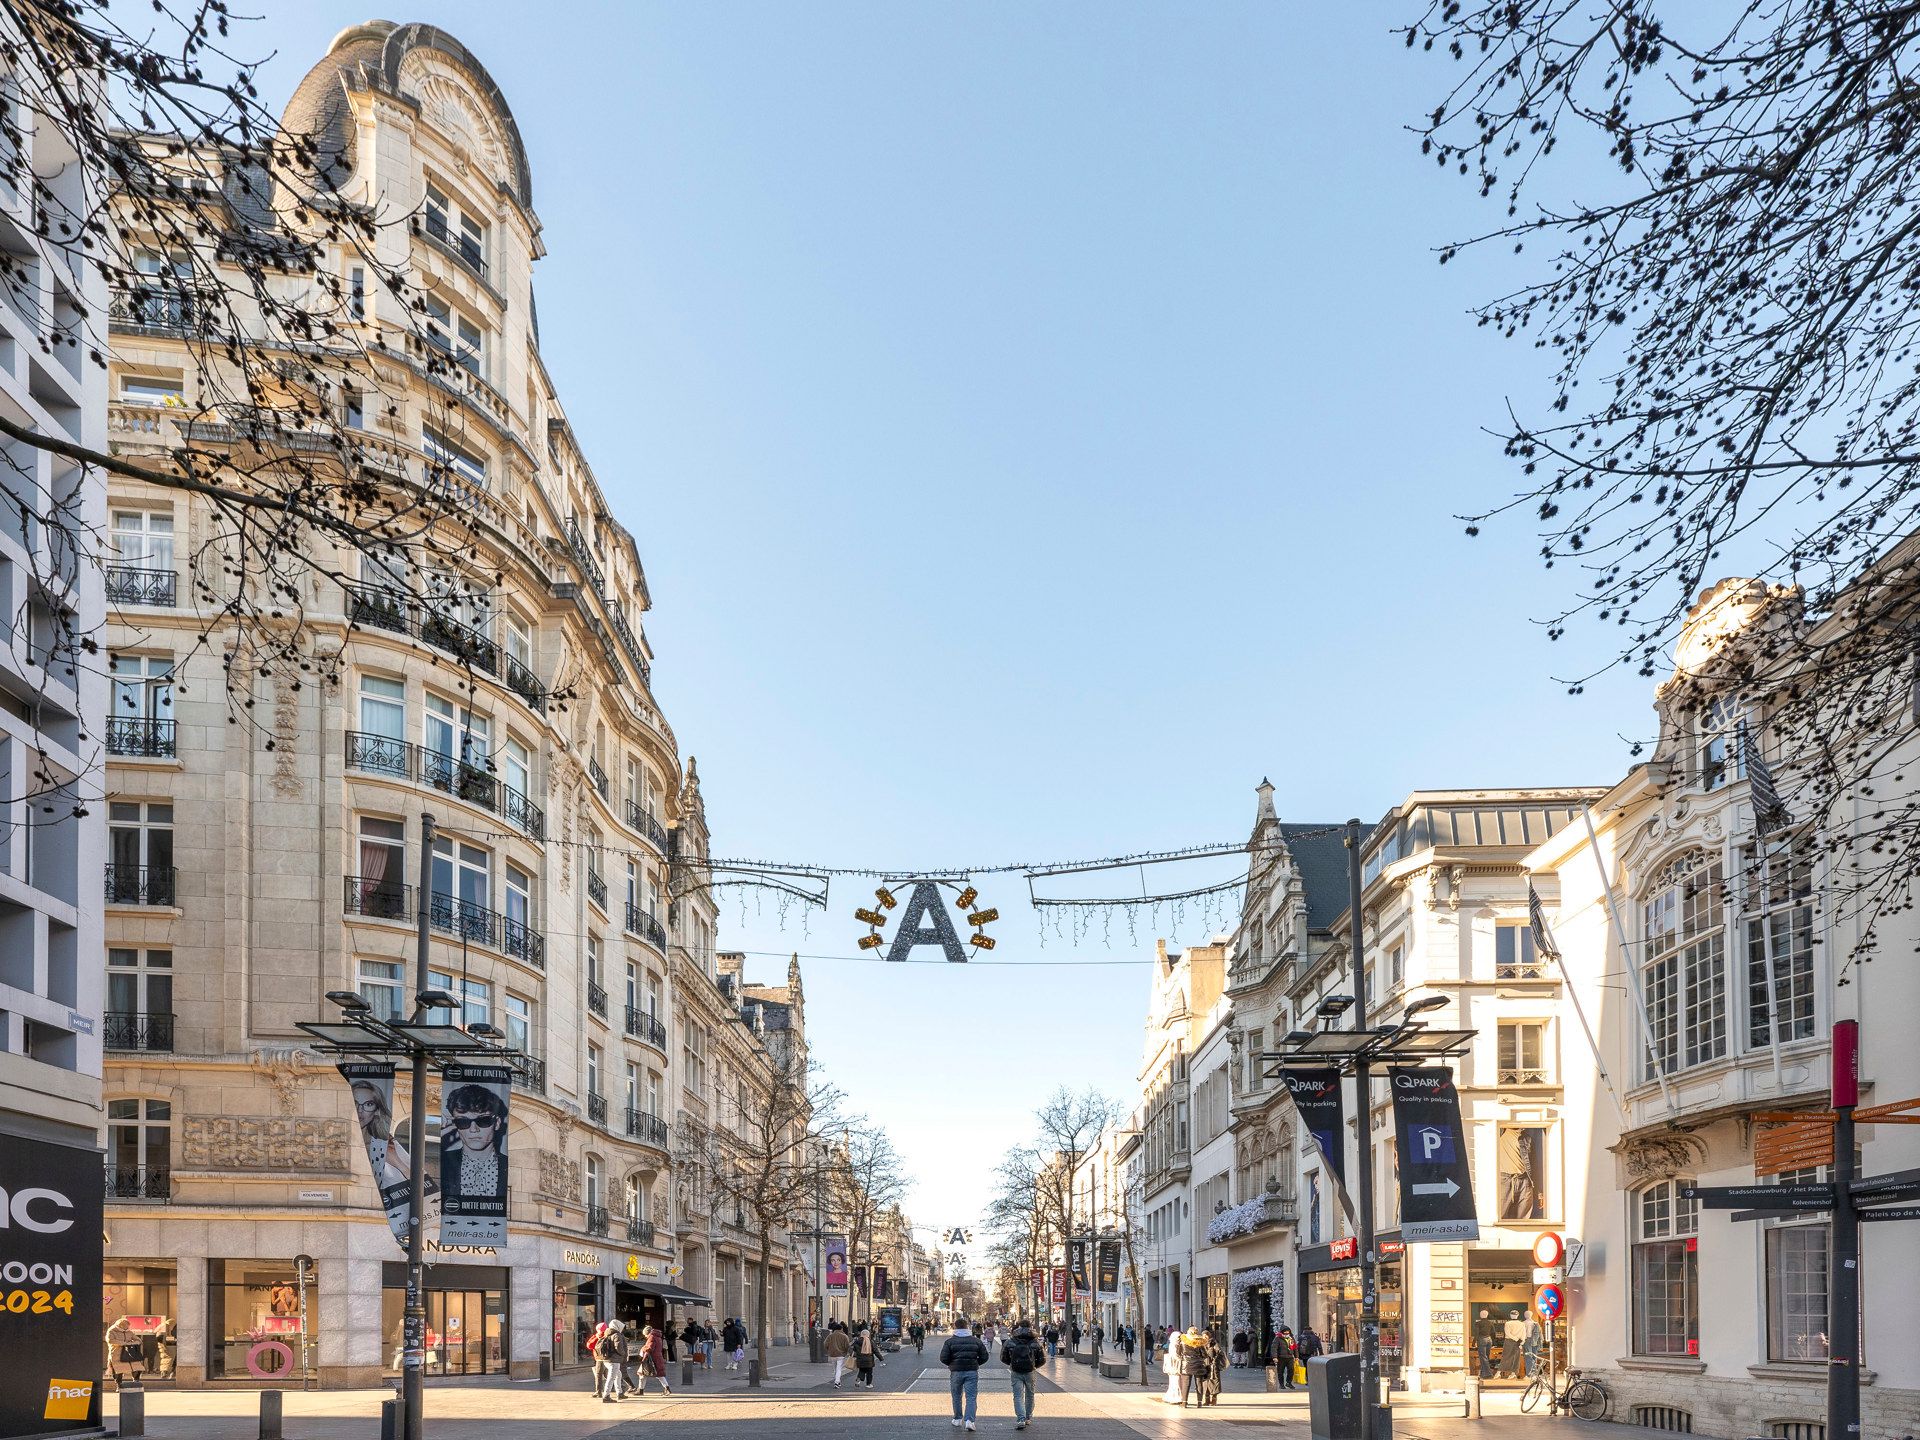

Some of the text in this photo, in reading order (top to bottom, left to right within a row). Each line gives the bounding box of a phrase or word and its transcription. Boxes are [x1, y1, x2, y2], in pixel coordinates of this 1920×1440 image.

[73, 1019, 91, 1029] MEIR
[463, 1069, 483, 1077] ODETTE
[1313, 1100, 1337, 1108] parking
[1430, 1096, 1453, 1104] parking
[1728, 1188, 1787, 1196] Stadsschouwburg
[1855, 1192, 1897, 1204] Stadsfeestzaal
[461, 1201, 504, 1210] ODETTE LUNETTES
[1865, 1210, 1889, 1218] Paleis
[1411, 1223, 1470, 1235] meir-as.be
[448, 1230, 499, 1239] meir-as.be
[1071, 1245, 1080, 1272] fnac
[1055, 1271, 1065, 1299] HEMA
[48, 1386, 92, 1400] fnac
